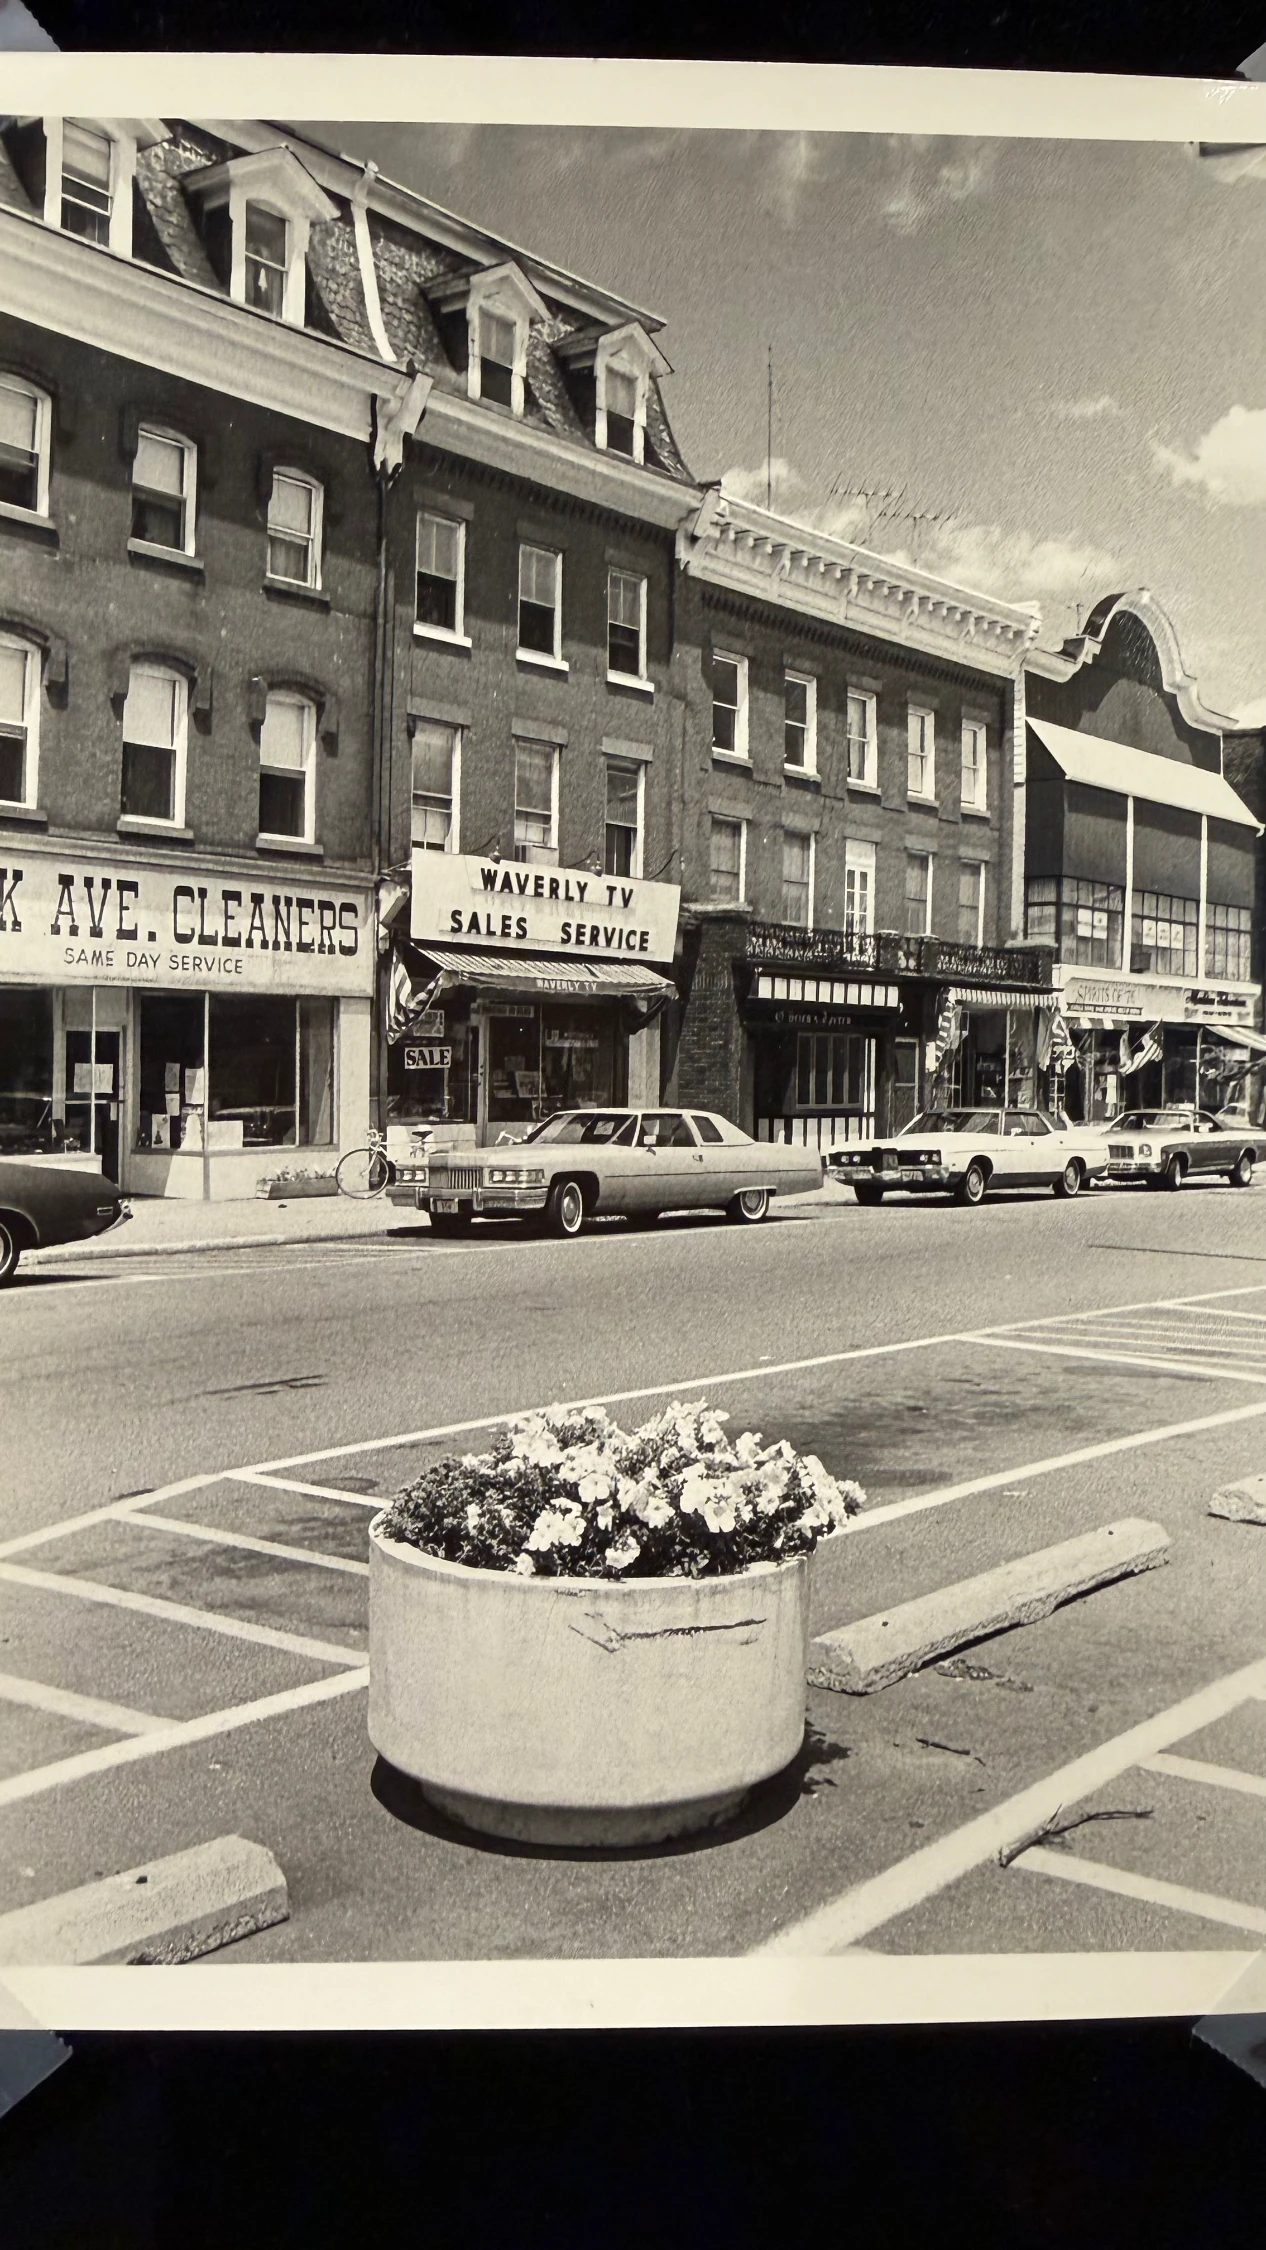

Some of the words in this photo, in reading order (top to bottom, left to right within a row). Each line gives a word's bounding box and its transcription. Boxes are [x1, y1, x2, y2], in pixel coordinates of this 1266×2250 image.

[480, 867, 588, 904] WAVERLY
[605, 885, 634, 909] TV
[51, 873, 157, 942] AVE.
[173, 884, 359, 957] CLEANERS
[450, 909, 528, 940] SALES
[560, 921, 650, 952] SERVICE
[63, 947, 115, 967] SAME
[126, 953, 160, 969] DAY
[168, 957, 244, 974] SERVICE
[584, 982, 598, 993] TV
[405, 1048, 450, 1066] SALE
